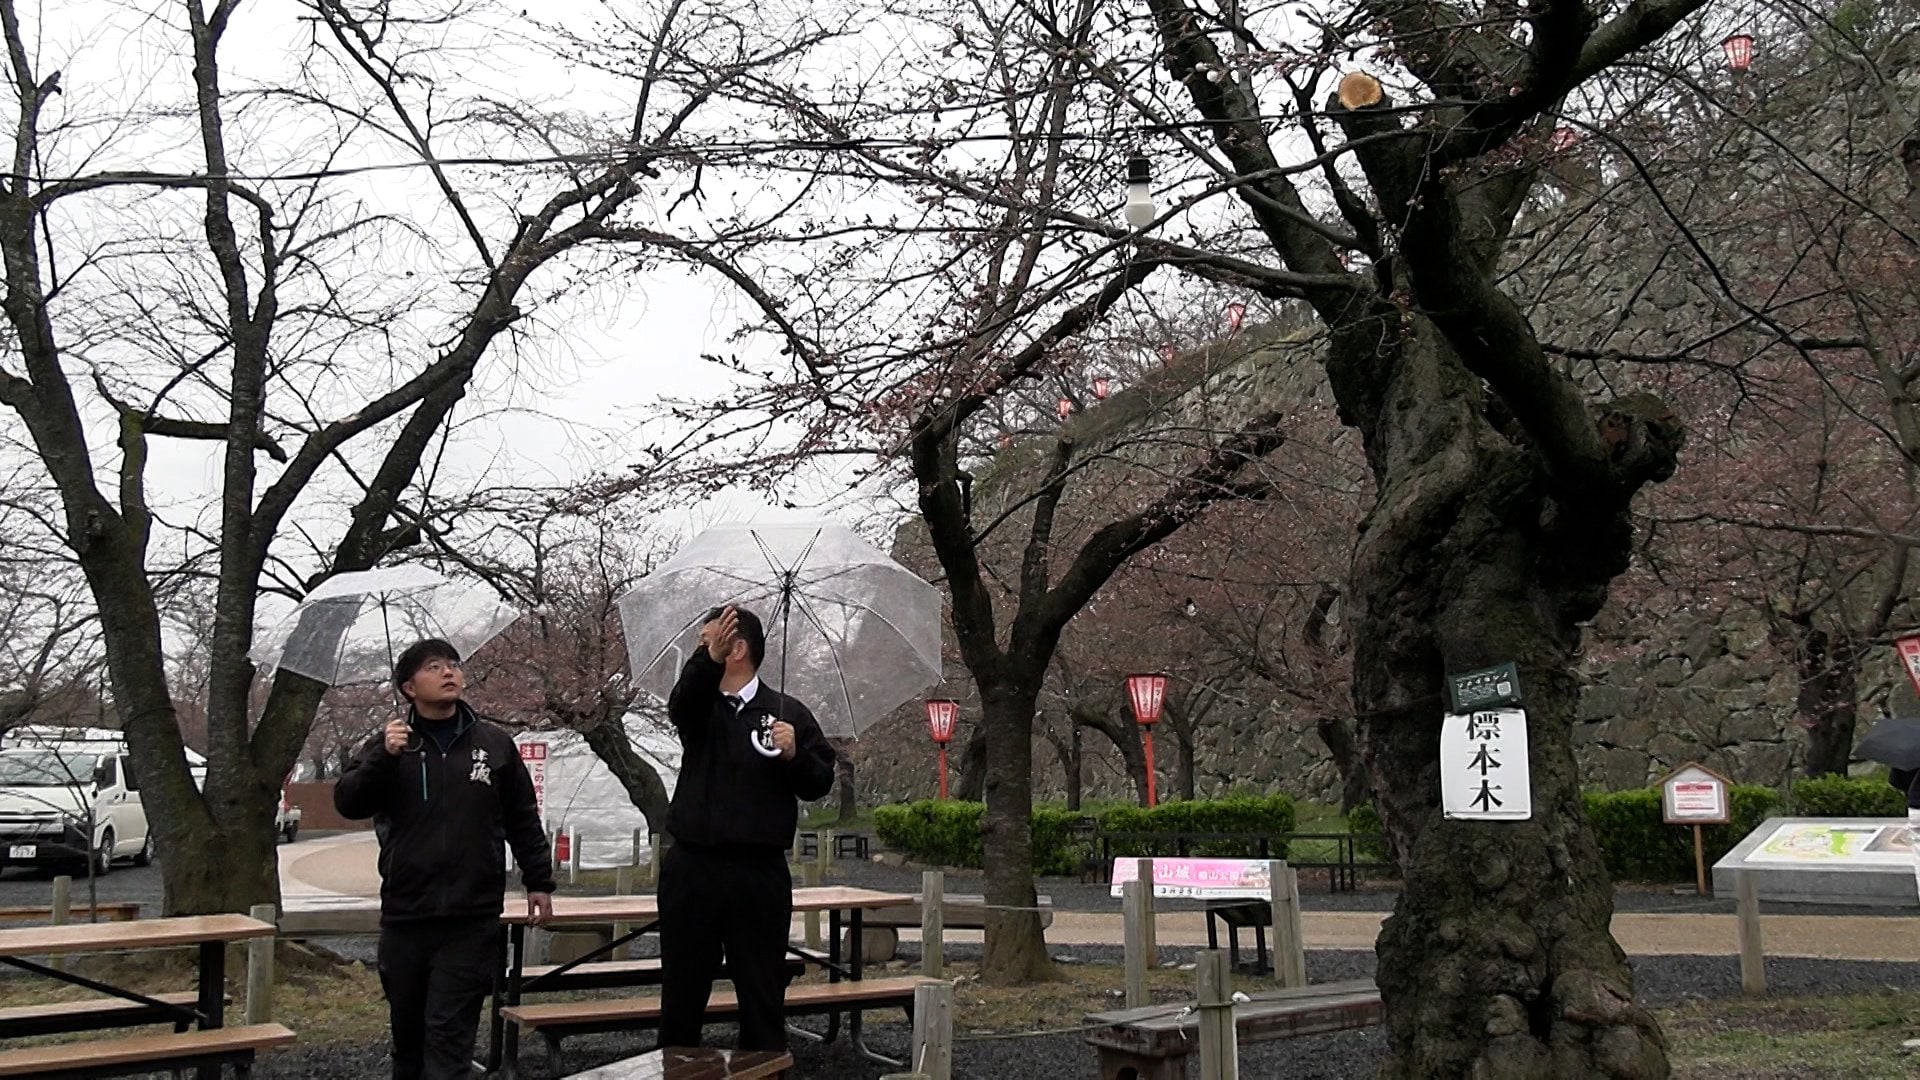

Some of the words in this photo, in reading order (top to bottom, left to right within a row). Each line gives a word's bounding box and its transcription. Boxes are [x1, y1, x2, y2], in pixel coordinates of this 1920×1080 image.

[1466, 713, 1504, 812] 標本木
[1153, 864, 1190, 880] 山城
